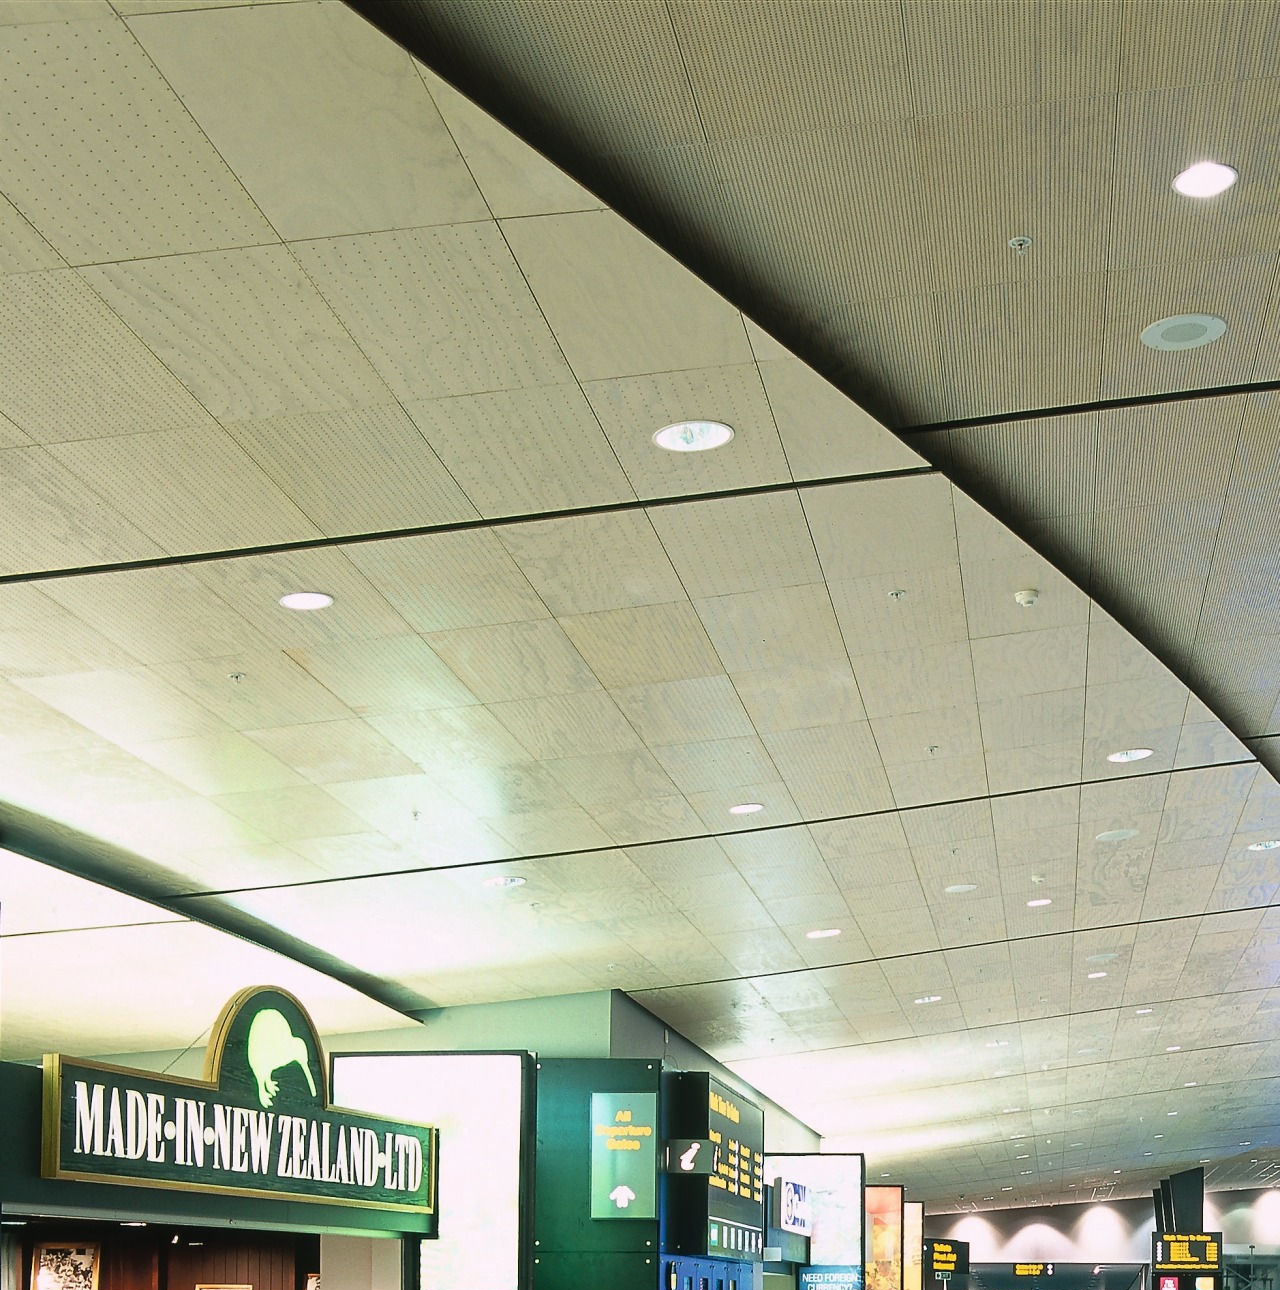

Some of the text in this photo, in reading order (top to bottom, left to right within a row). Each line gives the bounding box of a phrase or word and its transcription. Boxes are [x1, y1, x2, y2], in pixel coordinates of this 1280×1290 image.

[615, 1110, 632, 1122] All
[73, 1081, 423, 1192] MADE IN NEW ZEALAND LTD
[802, 1273, 858, 1282] NEED FOREIGN
